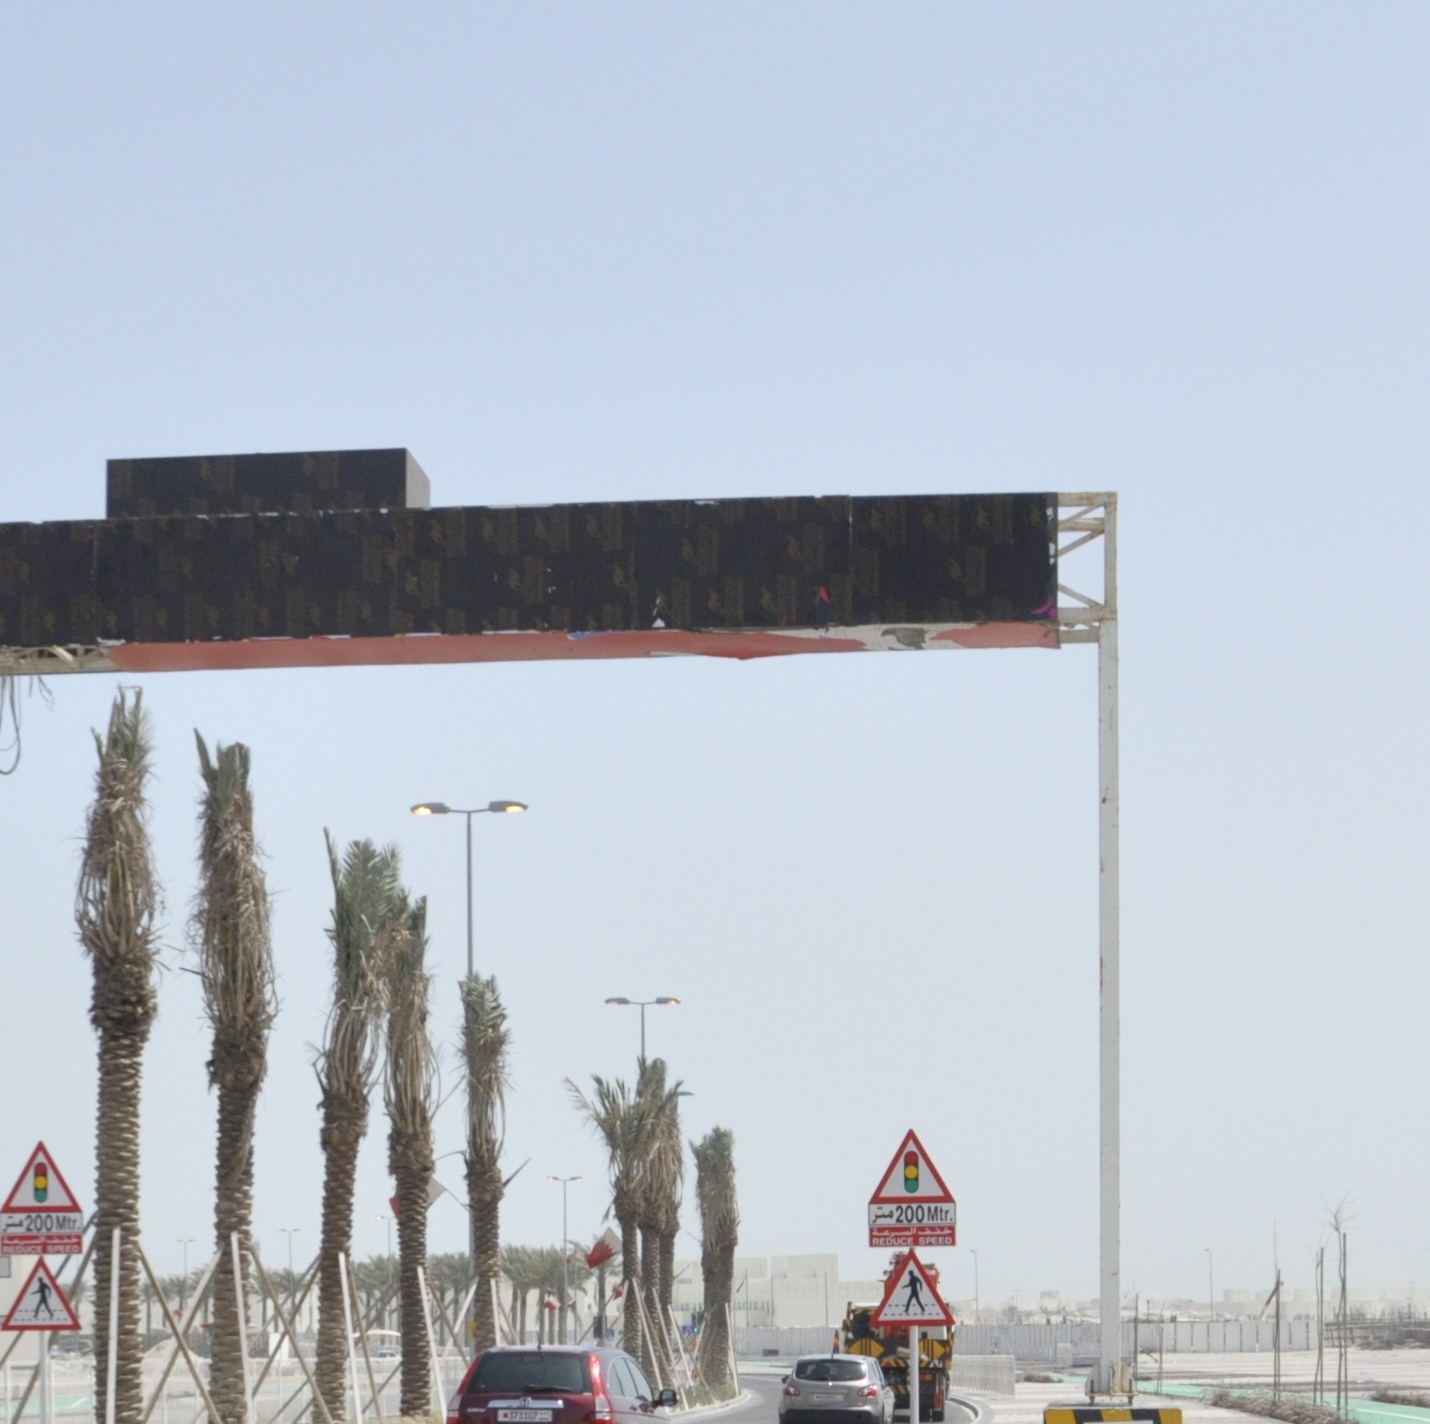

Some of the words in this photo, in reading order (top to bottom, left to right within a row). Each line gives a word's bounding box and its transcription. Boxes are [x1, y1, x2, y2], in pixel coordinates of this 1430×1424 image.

[872, 1206, 893, 1223] متر
[895, 1205, 925, 1223] 200
[927, 1205, 953, 1222] Mtr.
[2, 1216, 24, 1232] متر
[25, 1214, 53, 1232] 200
[55, 1215, 81, 1231] Mtr.
[872, 1227, 917, 1237] السرعة
[918, 1226, 953, 1235] خفف
[872, 1237, 914, 1246] REDUCE
[918, 1236, 953, 1245] SPEED
[2, 1245, 43, 1254] REDUCE
[46, 1245, 81, 1253] SPEED
